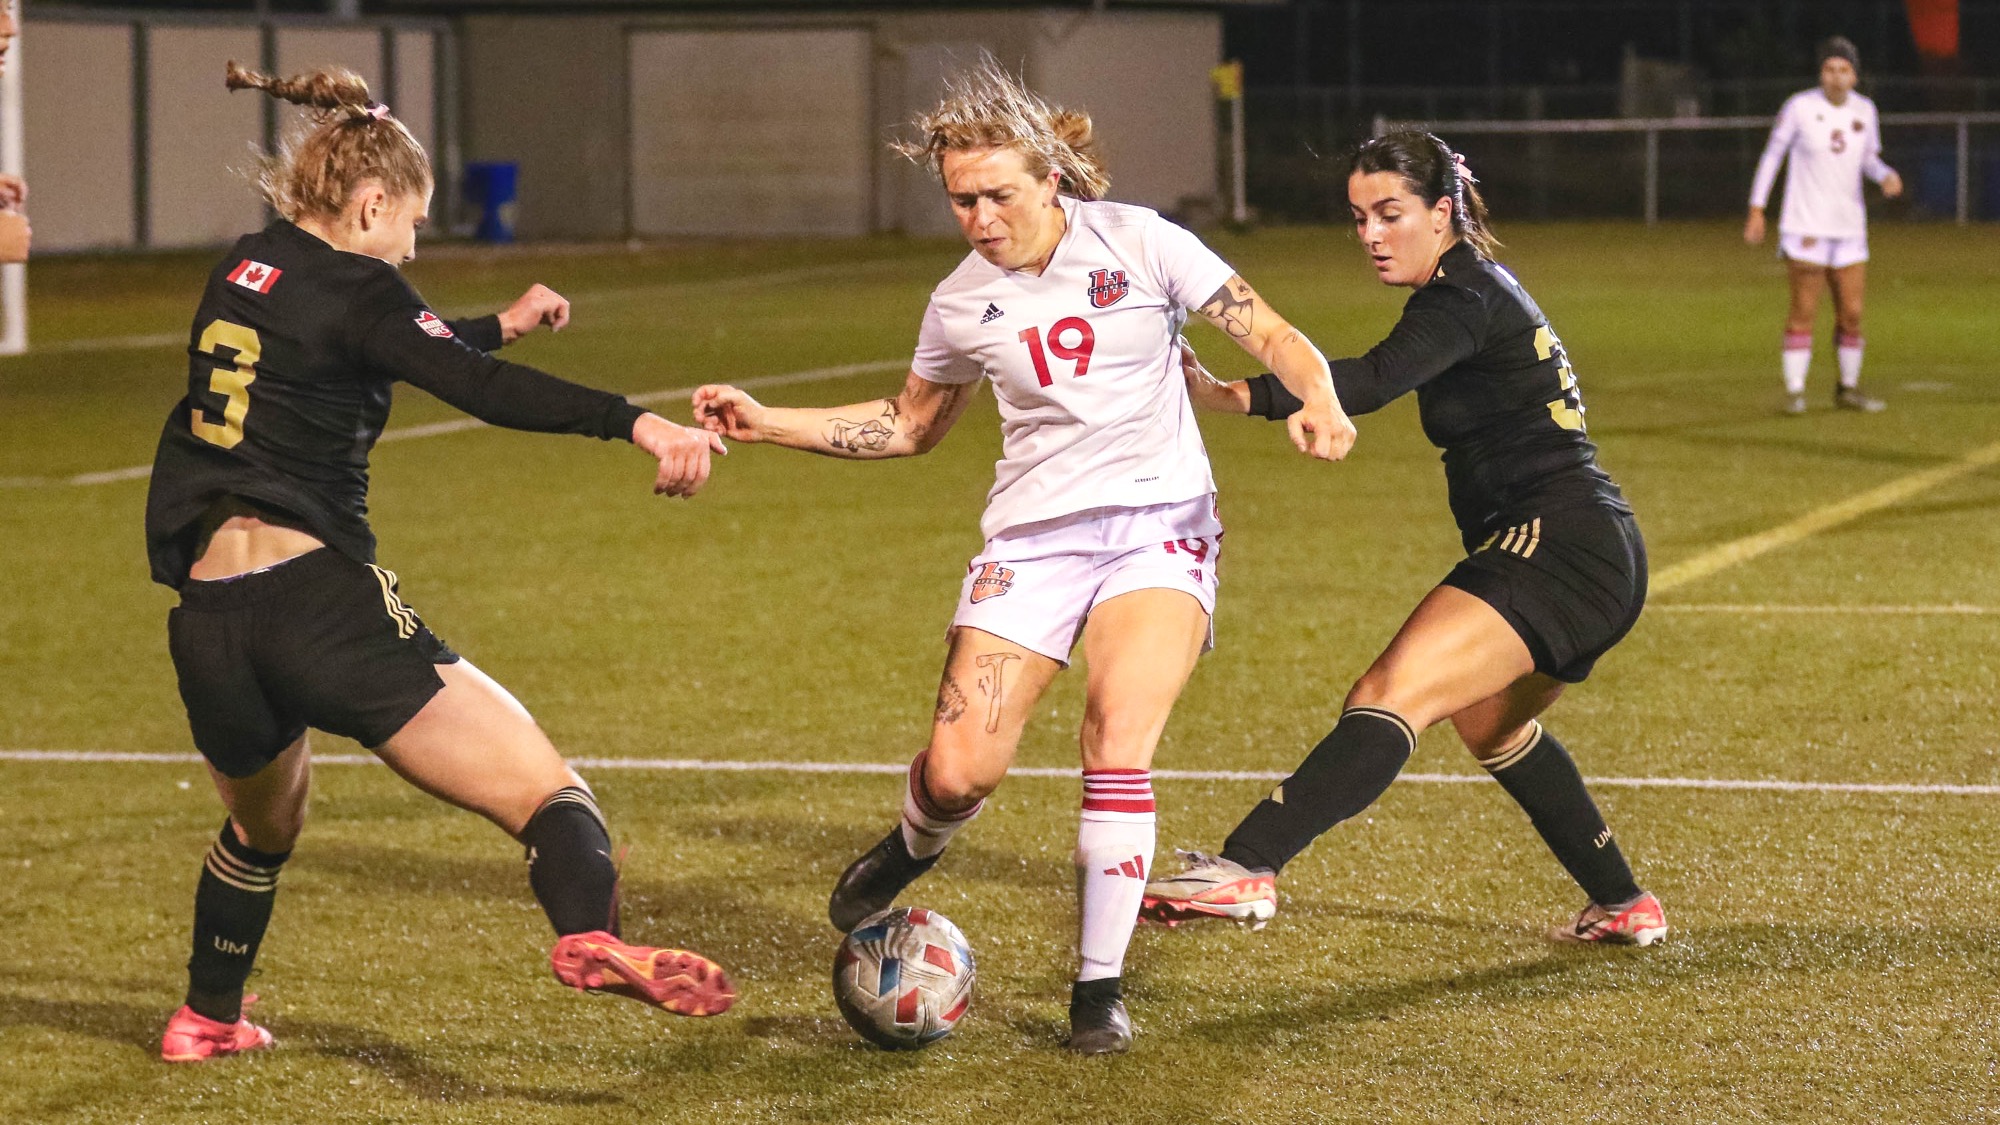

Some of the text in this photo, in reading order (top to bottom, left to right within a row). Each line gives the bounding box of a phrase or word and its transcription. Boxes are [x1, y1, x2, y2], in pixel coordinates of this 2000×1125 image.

[980, 311, 1004, 325] adidas
[1018, 316, 1095, 388] 19
[190, 318, 262, 450] 3
[1533, 324, 1587, 431] 3
[1594, 824, 1613, 849] UM
[214, 935, 249, 955] UM
